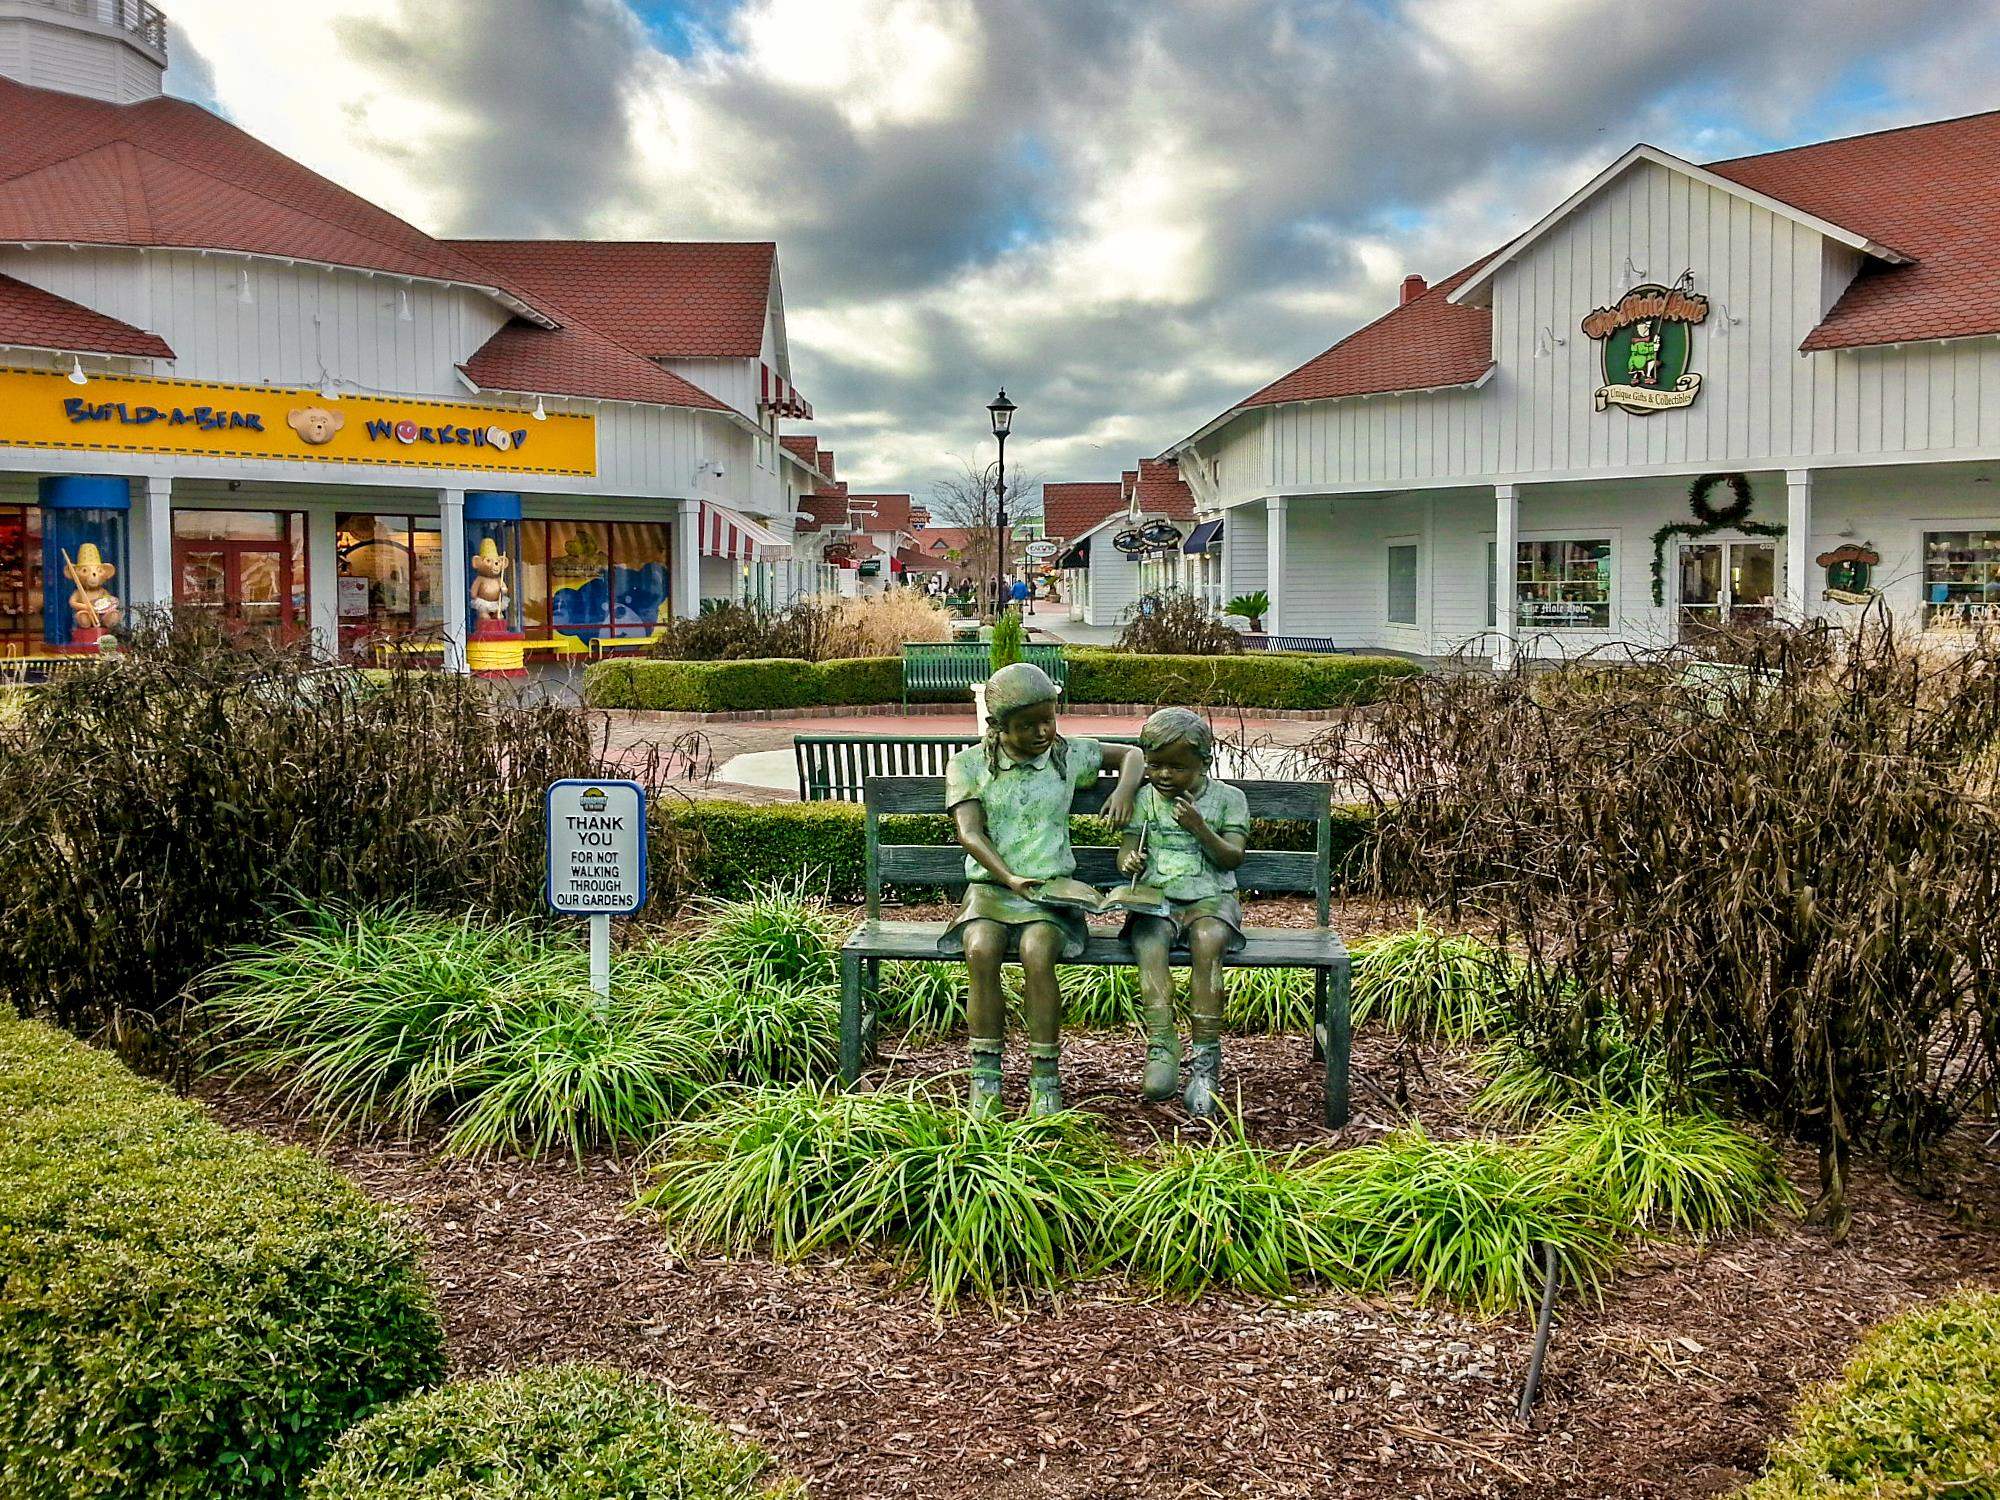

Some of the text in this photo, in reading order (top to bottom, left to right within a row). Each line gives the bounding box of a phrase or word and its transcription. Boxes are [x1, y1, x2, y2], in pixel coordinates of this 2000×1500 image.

[1610, 387, 1692, 406] Unique Gifts & Collectibles
[365, 418, 528, 451] WORKSHOP
[565, 816, 624, 831] THANK
[577, 832, 613, 846] YOU
[571, 851, 619, 864] FOR NOT
[570, 865, 620, 878] WALKING
[569, 879, 621, 892] THROUGH
[557, 893, 634, 907] OUR GARDENS
